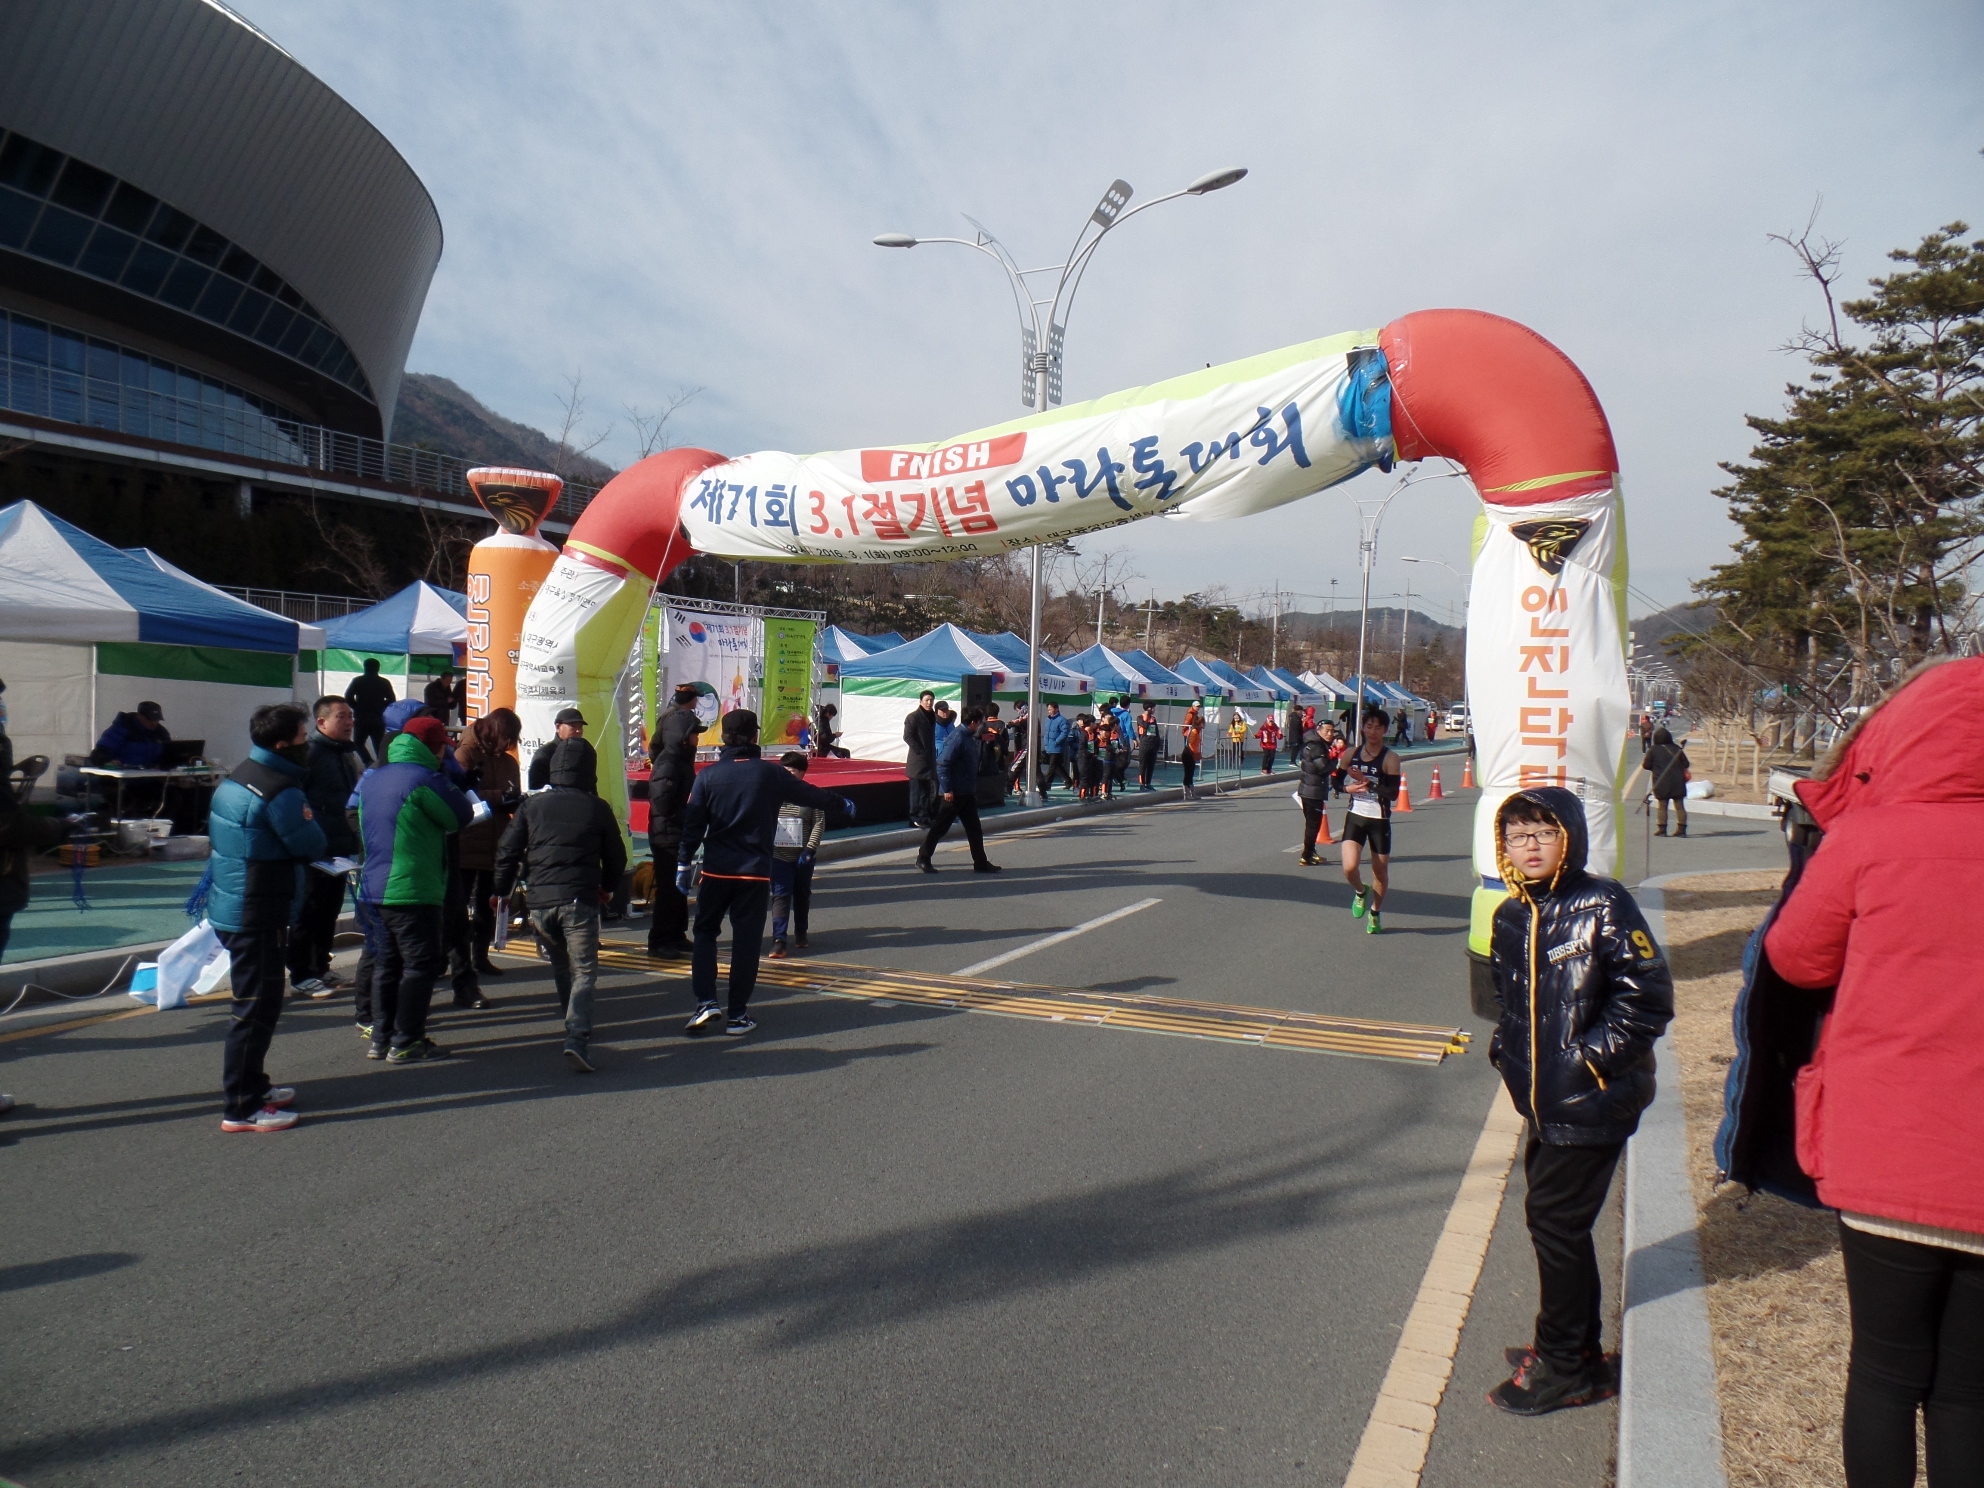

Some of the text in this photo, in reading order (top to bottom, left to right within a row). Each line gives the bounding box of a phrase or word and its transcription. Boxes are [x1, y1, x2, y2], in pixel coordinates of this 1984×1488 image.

[690, 477, 799, 537] 제71회
[808, 479, 999, 541] 3.1절기념
[893, 543, 977, 559] 09:00~12:00
[1631, 929, 1655, 959] 9
